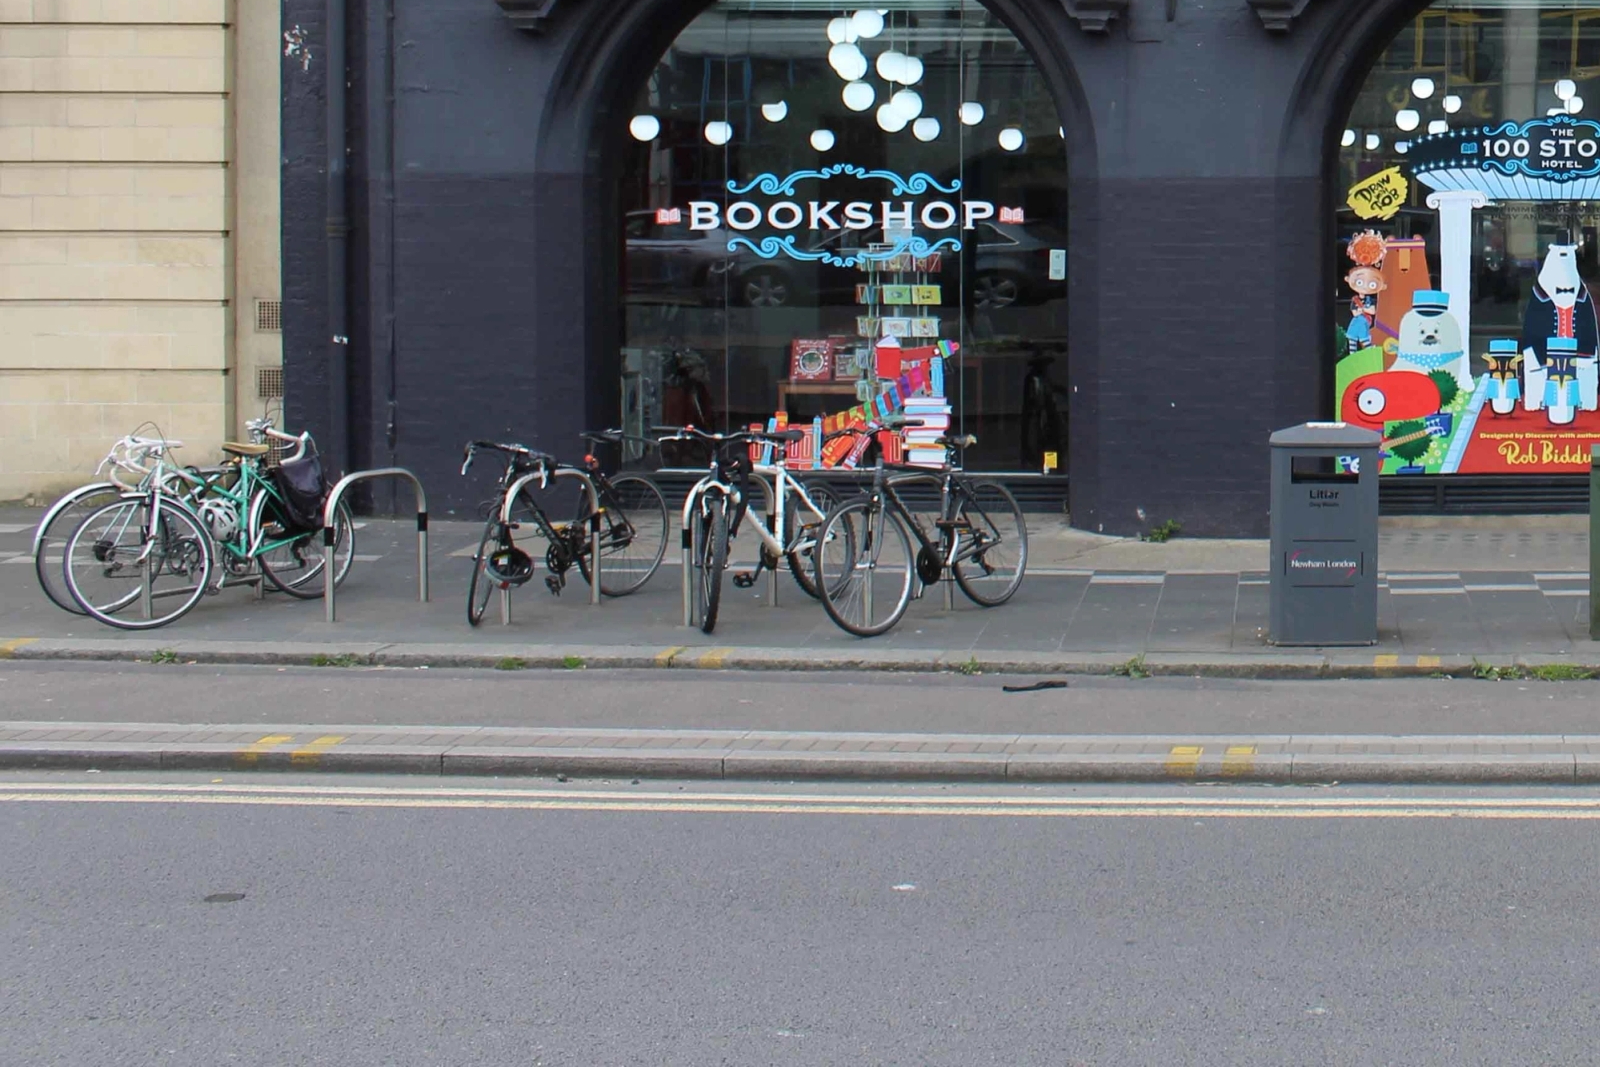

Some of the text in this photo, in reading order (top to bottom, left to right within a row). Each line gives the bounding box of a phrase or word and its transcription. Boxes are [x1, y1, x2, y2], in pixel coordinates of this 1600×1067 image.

[1551, 128, 1574, 137] THE
[1483, 139, 1530, 157] 100
[1541, 160, 1582, 168] HOTEL
[1354, 174, 1391, 202] DRAW
[689, 201, 995, 231] BOOKSHOP
[1498, 440, 1592, 465] Rob Biddu
[1291, 559, 1357, 568] Newham London
